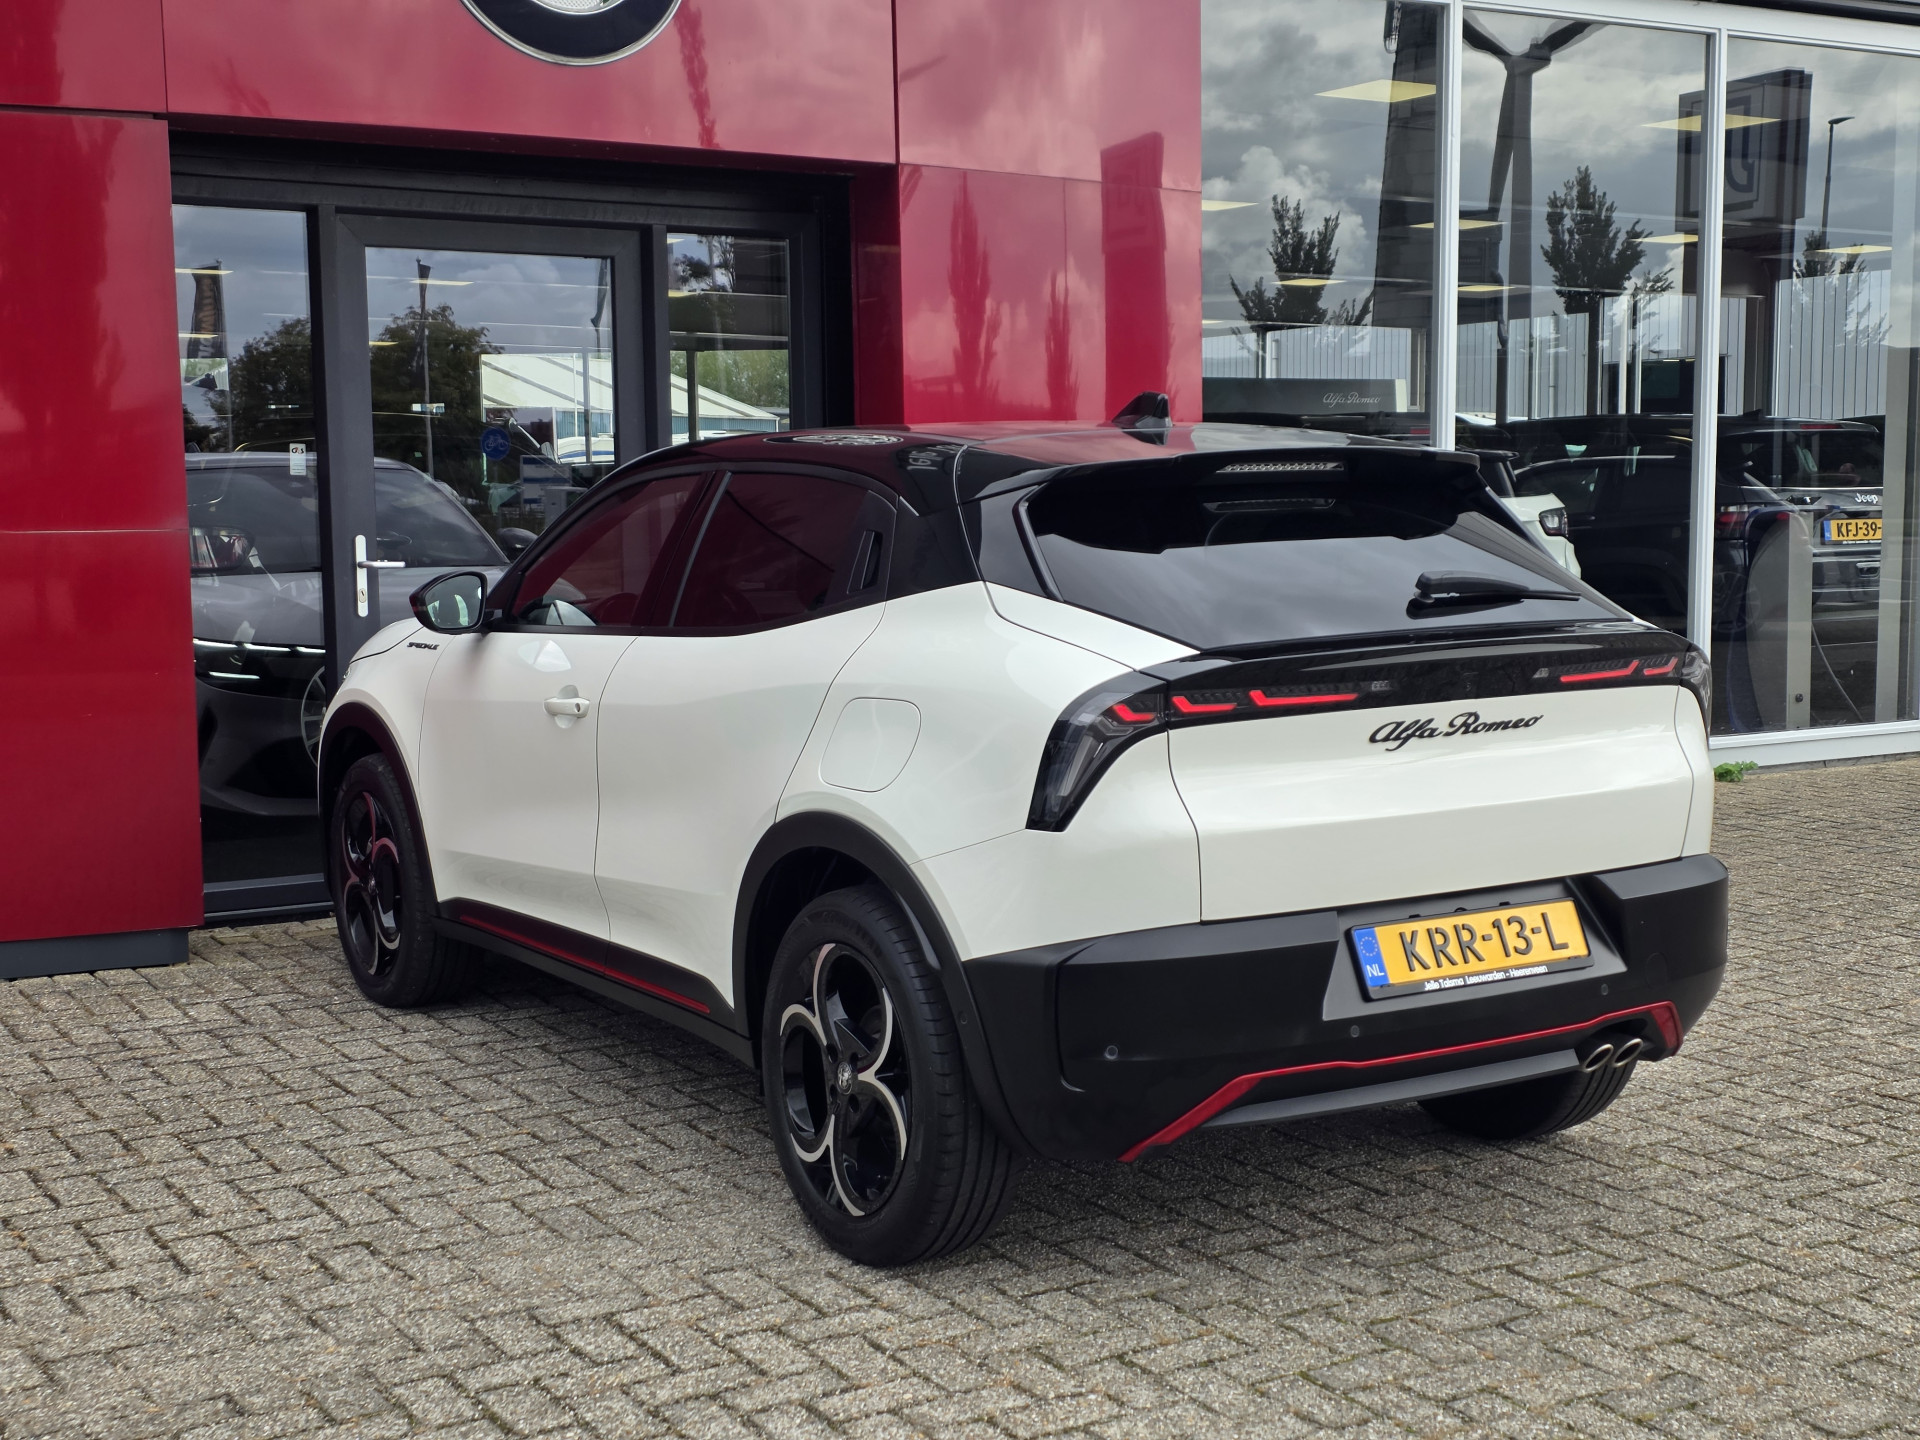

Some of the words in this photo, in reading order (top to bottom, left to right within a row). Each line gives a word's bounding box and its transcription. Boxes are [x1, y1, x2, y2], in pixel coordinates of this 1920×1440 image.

[1323, 392, 1345, 408] Alfa
[1347, 391, 1381, 404] Romeo
[1855, 493, 1879, 504] Jeep
[1369, 718, 1444, 751] Alfa
[1442, 711, 1545, 737] Romeo
[1366, 964, 1385, 978] NL
[1399, 912, 1570, 972] KRR-13-L
[1466, 971, 1505, 985] Leeuwarden
[1510, 965, 1548, 978] Heerenveen
